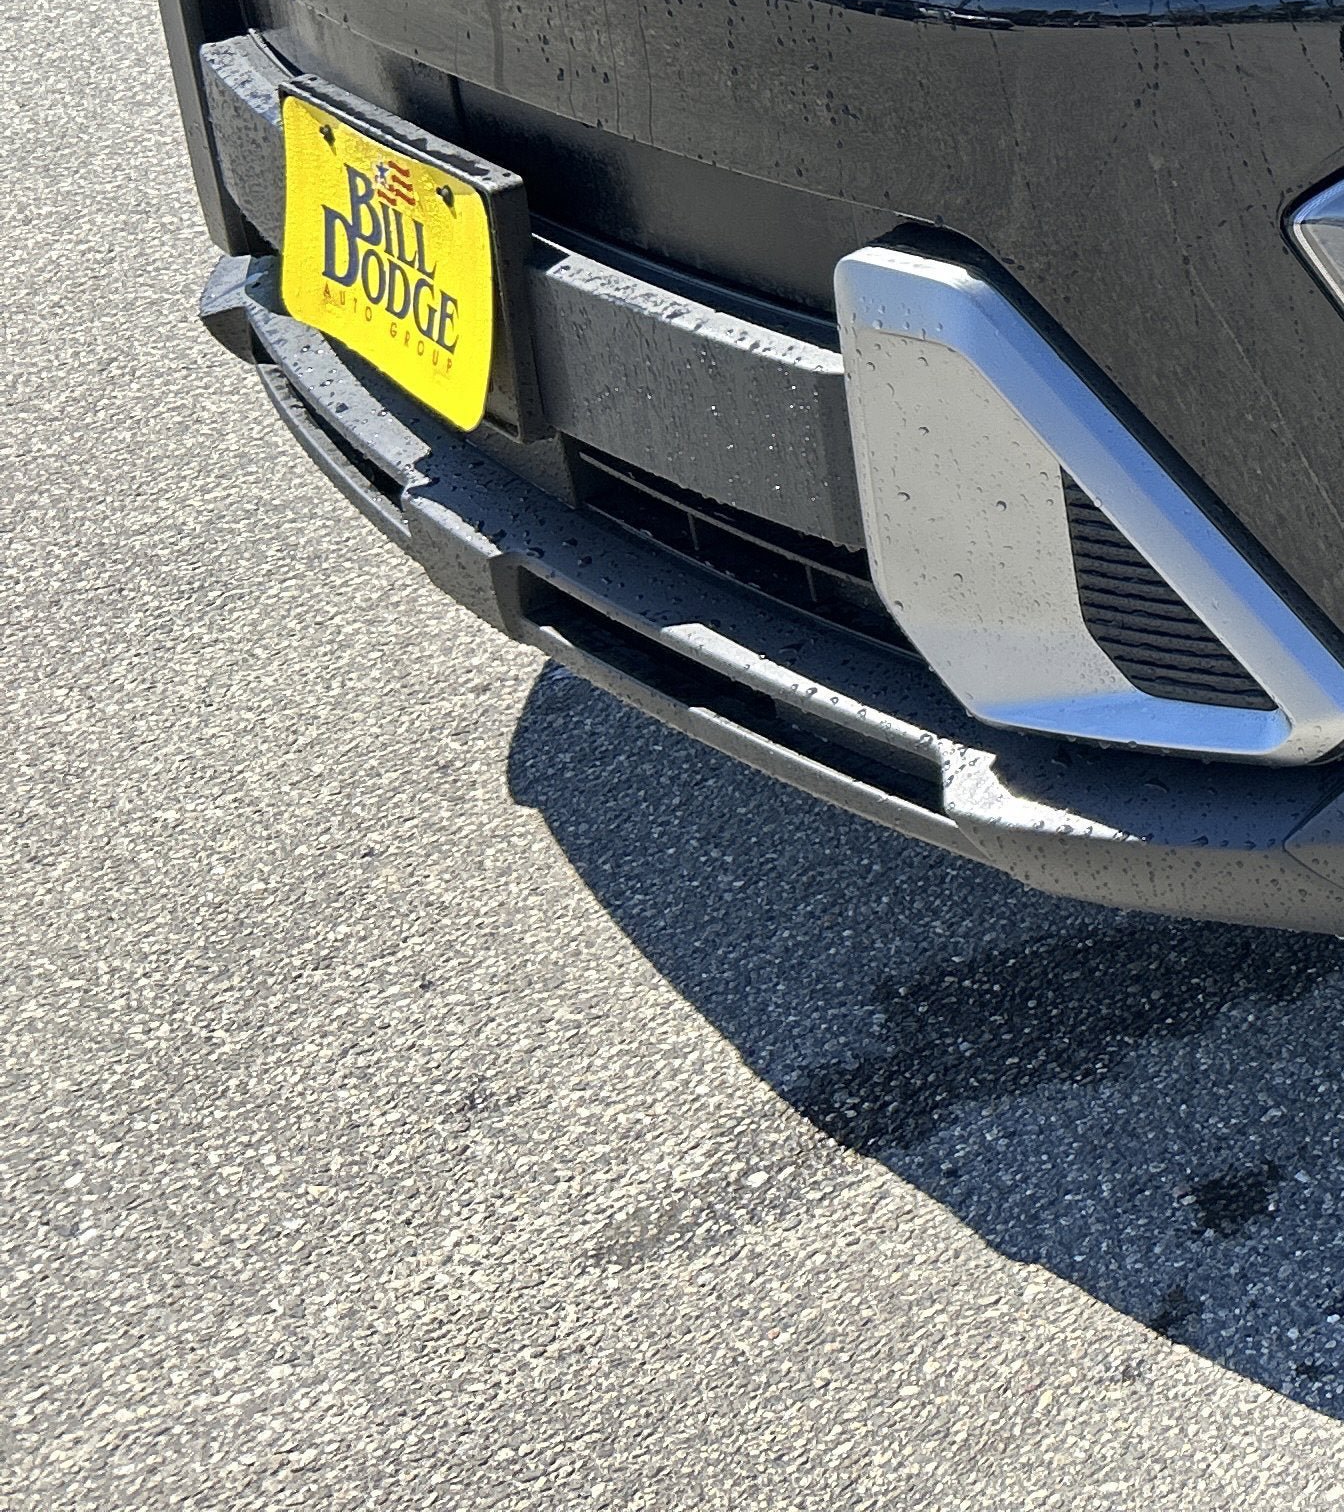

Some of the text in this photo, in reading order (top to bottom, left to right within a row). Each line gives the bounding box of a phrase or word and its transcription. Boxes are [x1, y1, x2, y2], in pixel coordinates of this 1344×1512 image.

[321, 204, 460, 354] DODGE
[344, 163, 437, 279] BILL
[322, 281, 454, 372] AUTO GROUP
